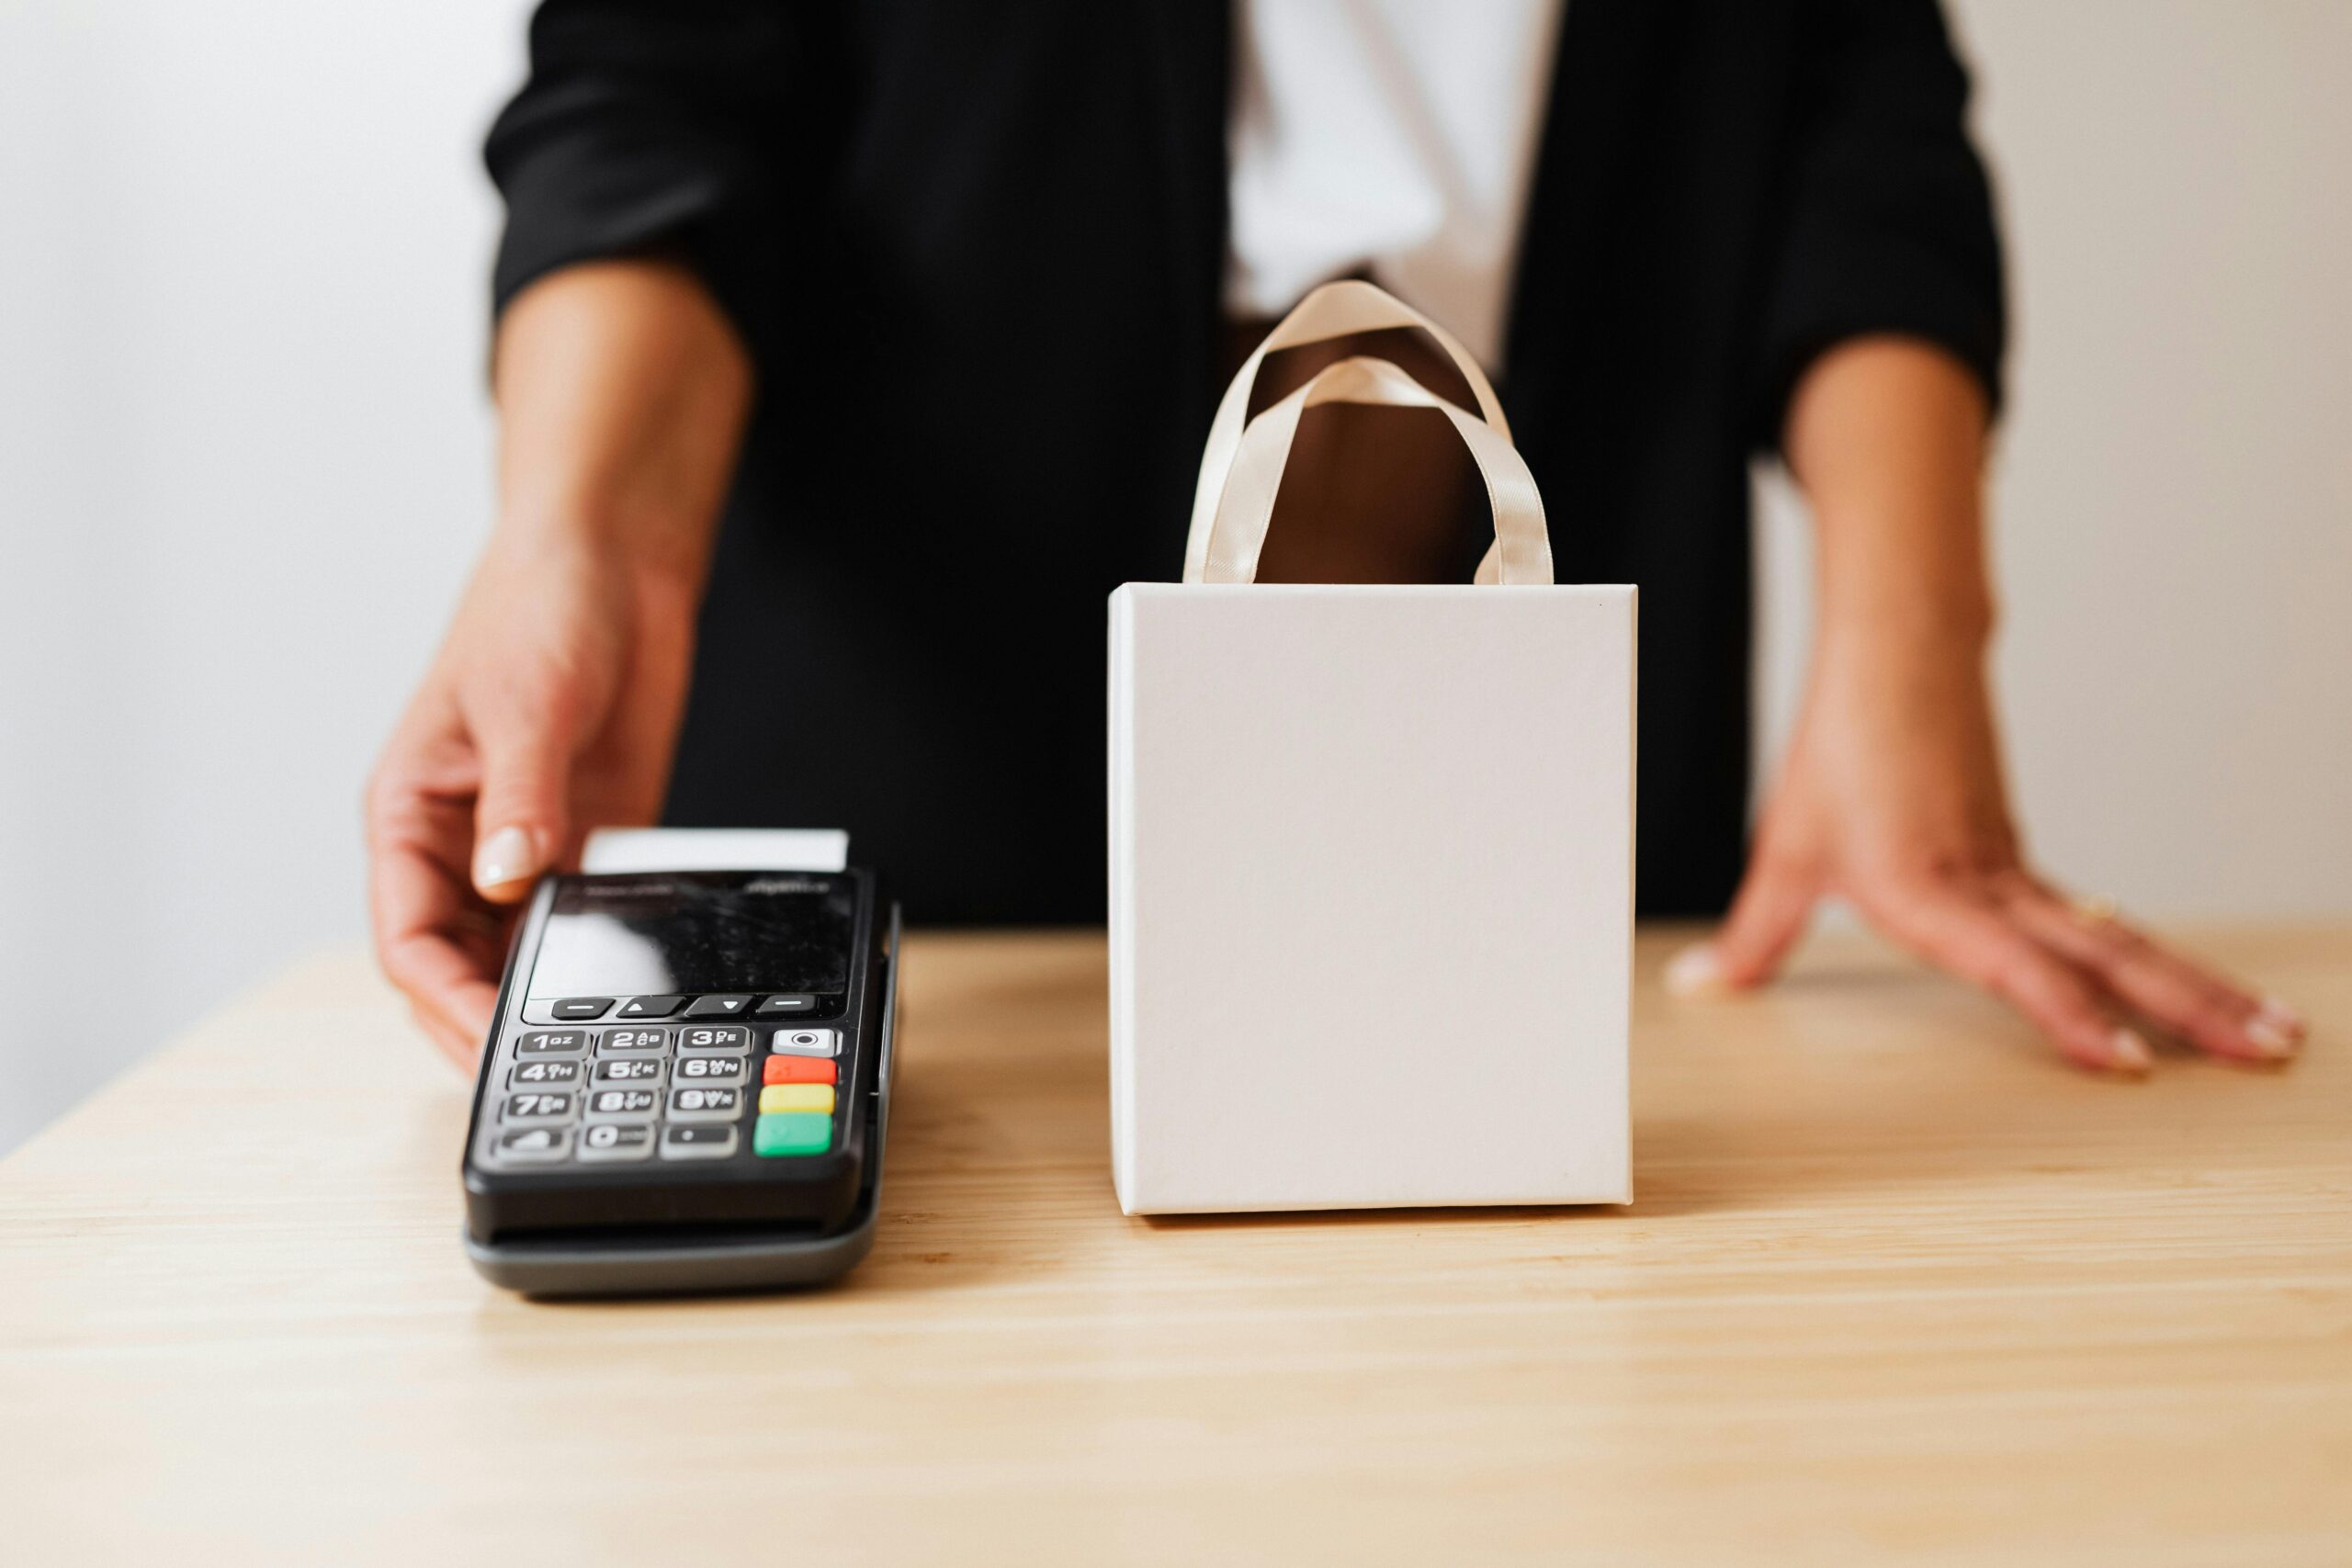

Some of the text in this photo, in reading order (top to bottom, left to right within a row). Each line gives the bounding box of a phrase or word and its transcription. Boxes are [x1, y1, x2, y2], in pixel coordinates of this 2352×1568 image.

[534, 1034, 548, 1049] 1
[612, 1032, 634, 1047] 2
[692, 1031, 712, 1045] 3
[521, 1064, 546, 1081] 4
[608, 1062, 630, 1078] 5
[684, 1060, 707, 1076] 6
[515, 1095, 538, 1115] 7
[598, 1092, 624, 1111] 8
